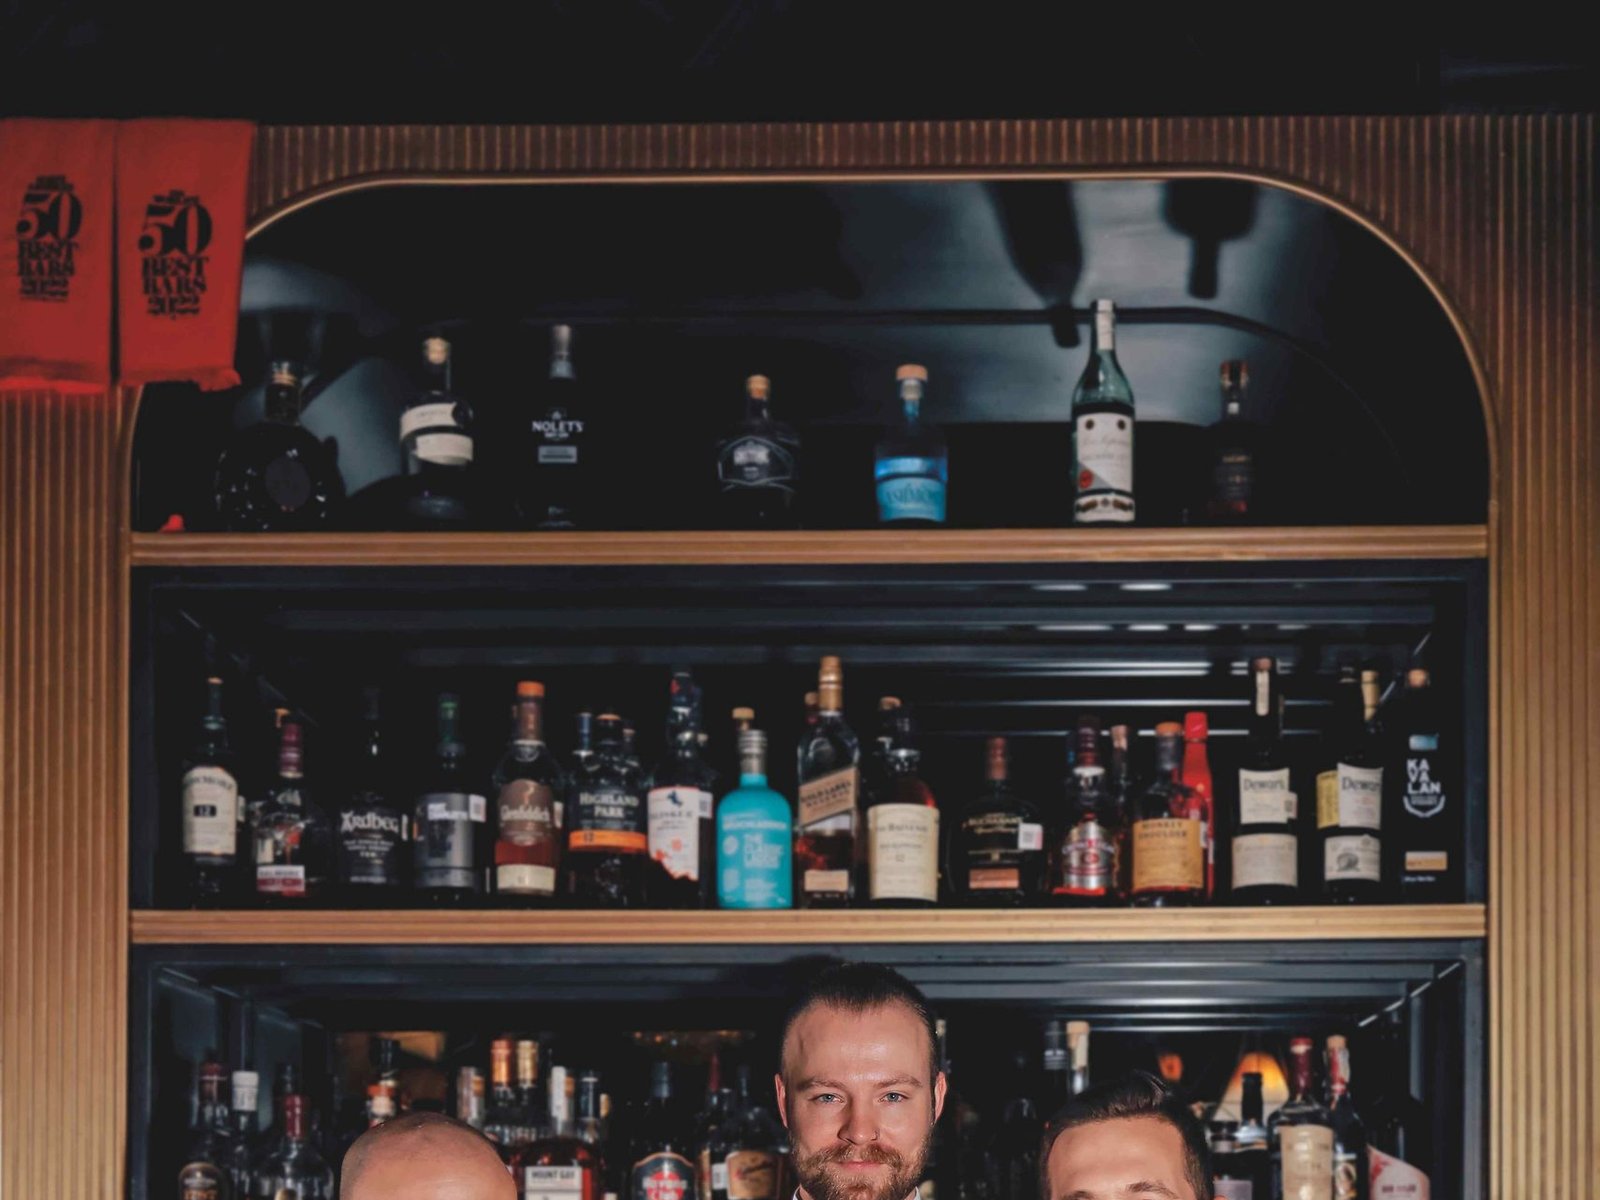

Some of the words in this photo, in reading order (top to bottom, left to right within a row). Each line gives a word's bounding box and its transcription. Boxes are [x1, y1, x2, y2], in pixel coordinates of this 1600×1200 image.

[16, 191, 83, 240] 50
[138, 203, 213, 257] 50
[18, 238, 79, 260] BEST
[142, 256, 209, 278] BEST
[143, 276, 207, 295] BARS
[579, 792, 639, 807] HIGHLAND
[593, 806, 626, 818] PARK
